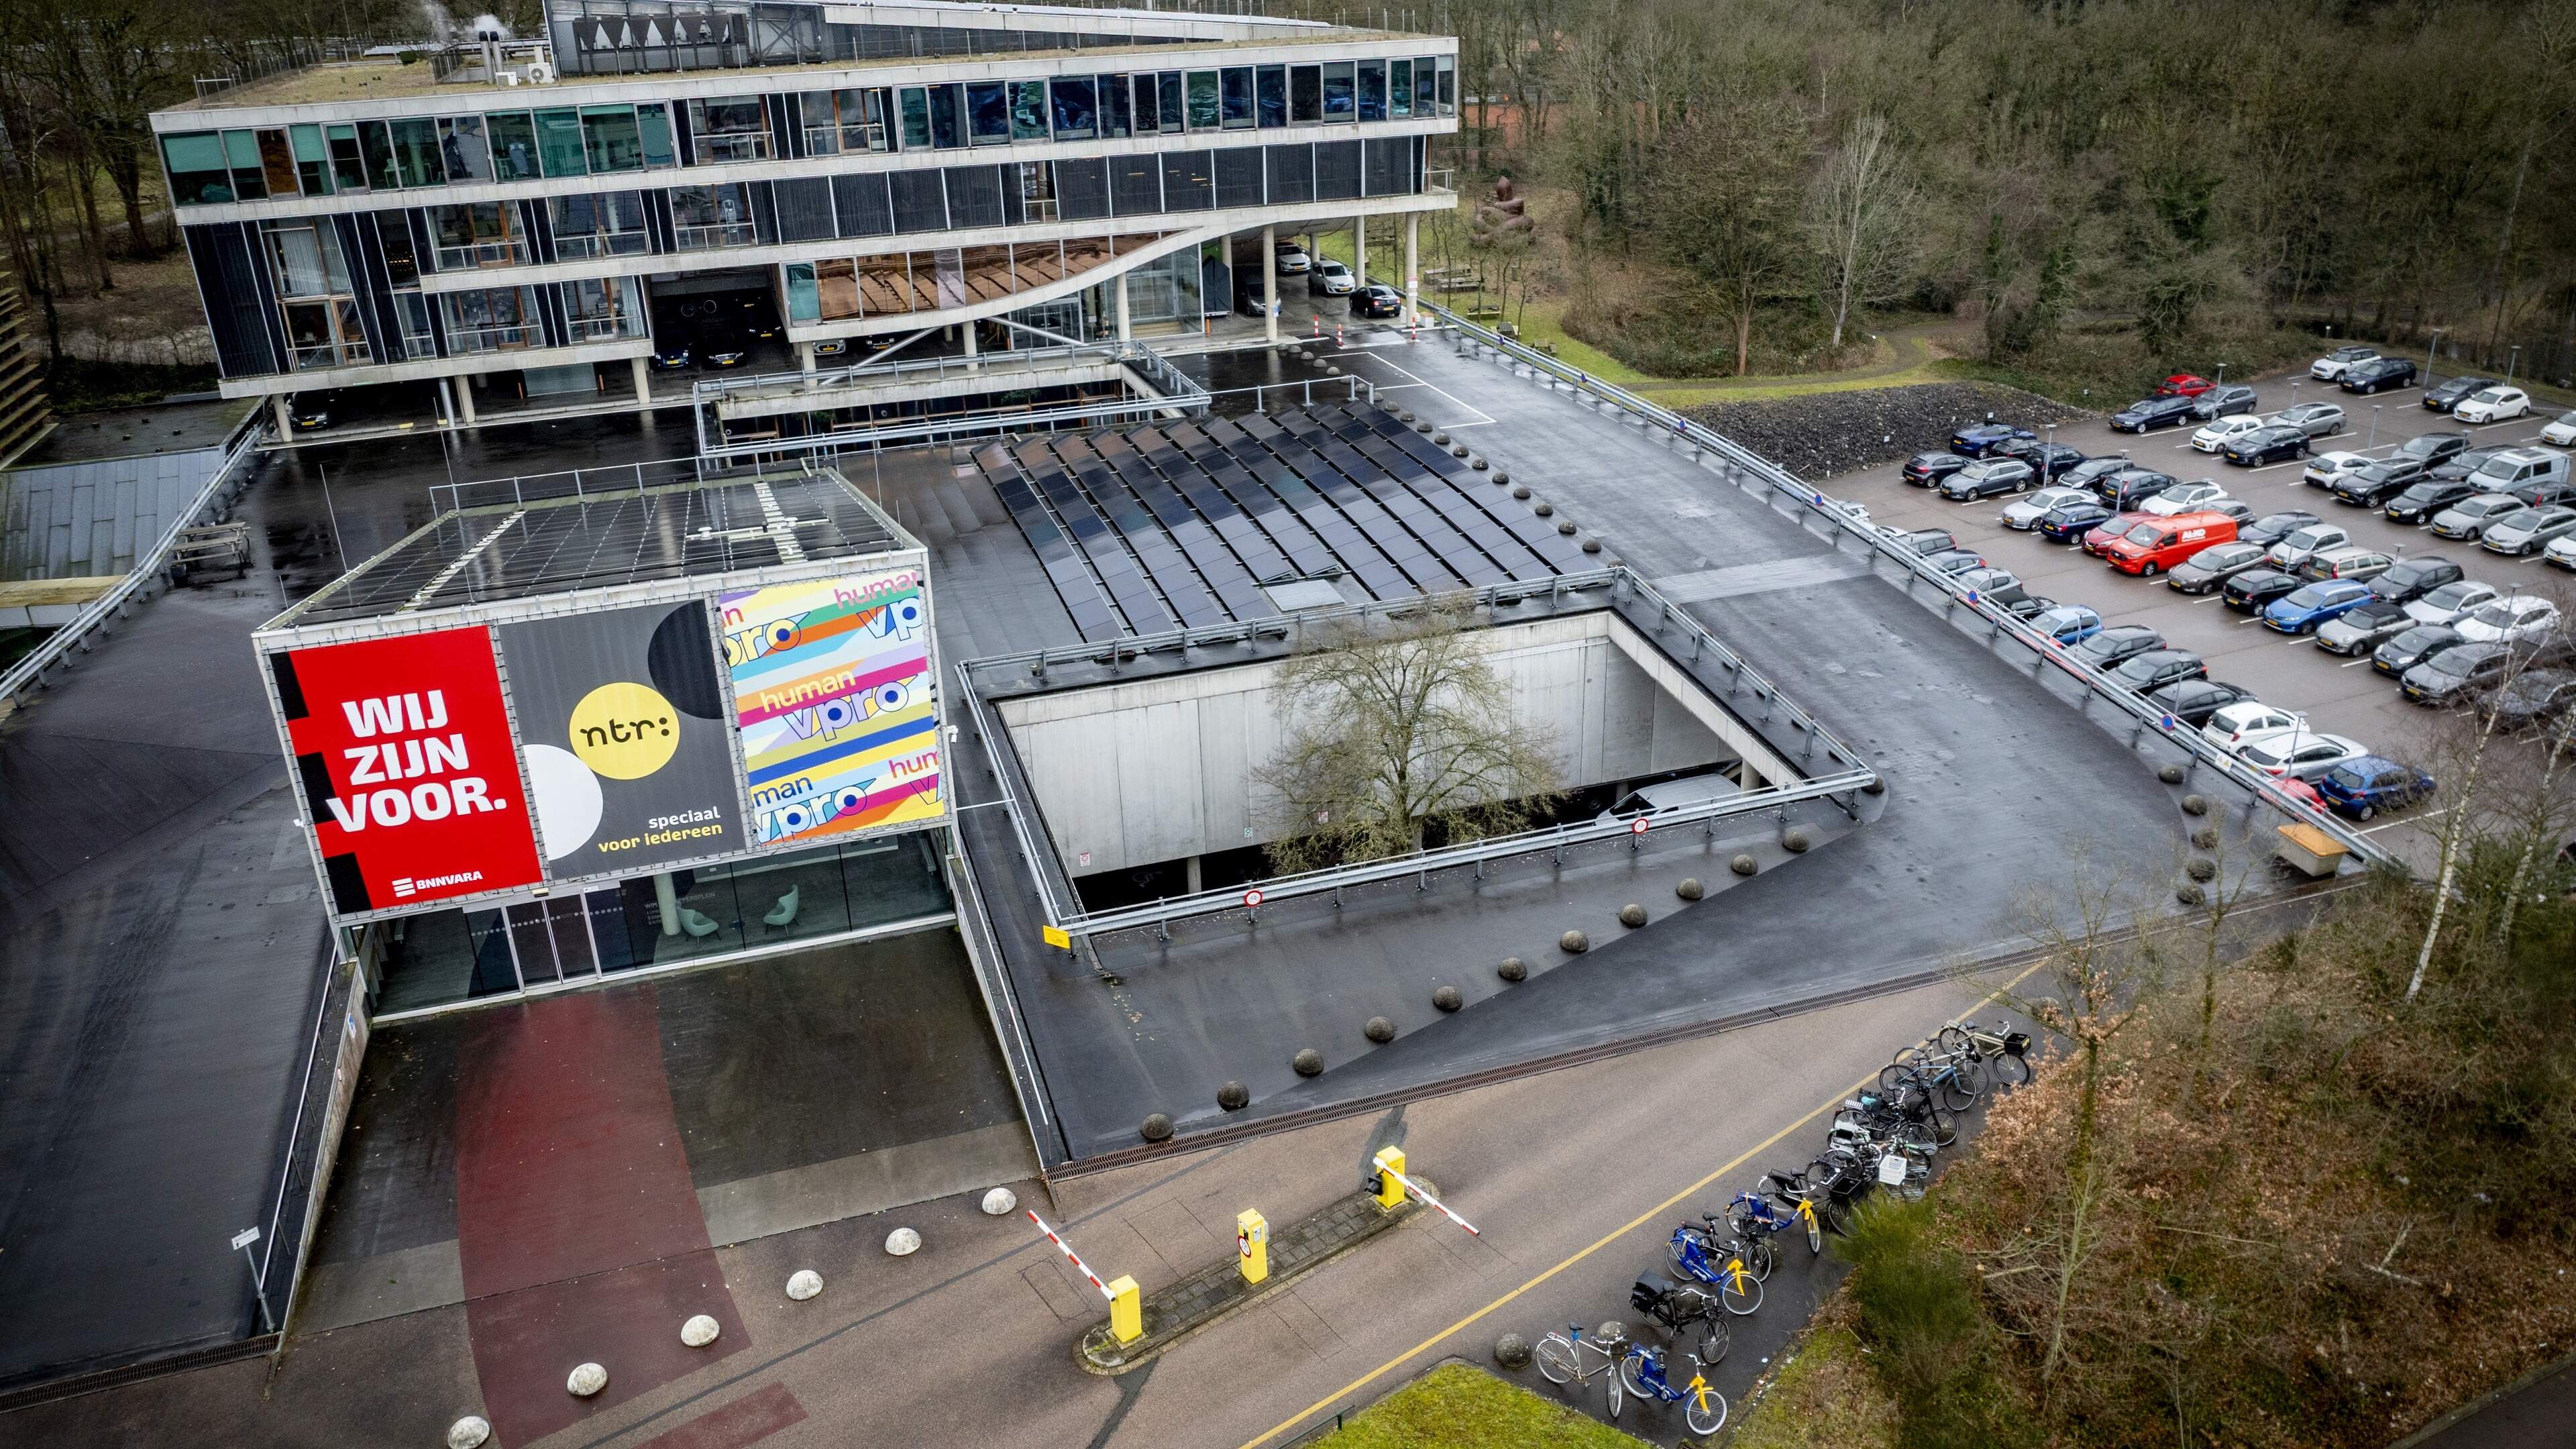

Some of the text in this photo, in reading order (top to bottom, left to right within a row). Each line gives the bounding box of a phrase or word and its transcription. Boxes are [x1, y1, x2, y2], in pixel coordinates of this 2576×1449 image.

[759, 670, 856, 712] human
[782, 674, 918, 742] vpro
[341, 689, 448, 738] WIJ
[580, 717, 669, 747] ntr:
[343, 733, 470, 786] ZIJN
[325, 776, 506, 833] VOOR.
[753, 776, 813, 807] man
[755, 778, 877, 845] vpro
[598, 823, 722, 853] voor iedereen
[648, 806, 721, 830] speciaal
[416, 870, 484, 890] BNNVARA
